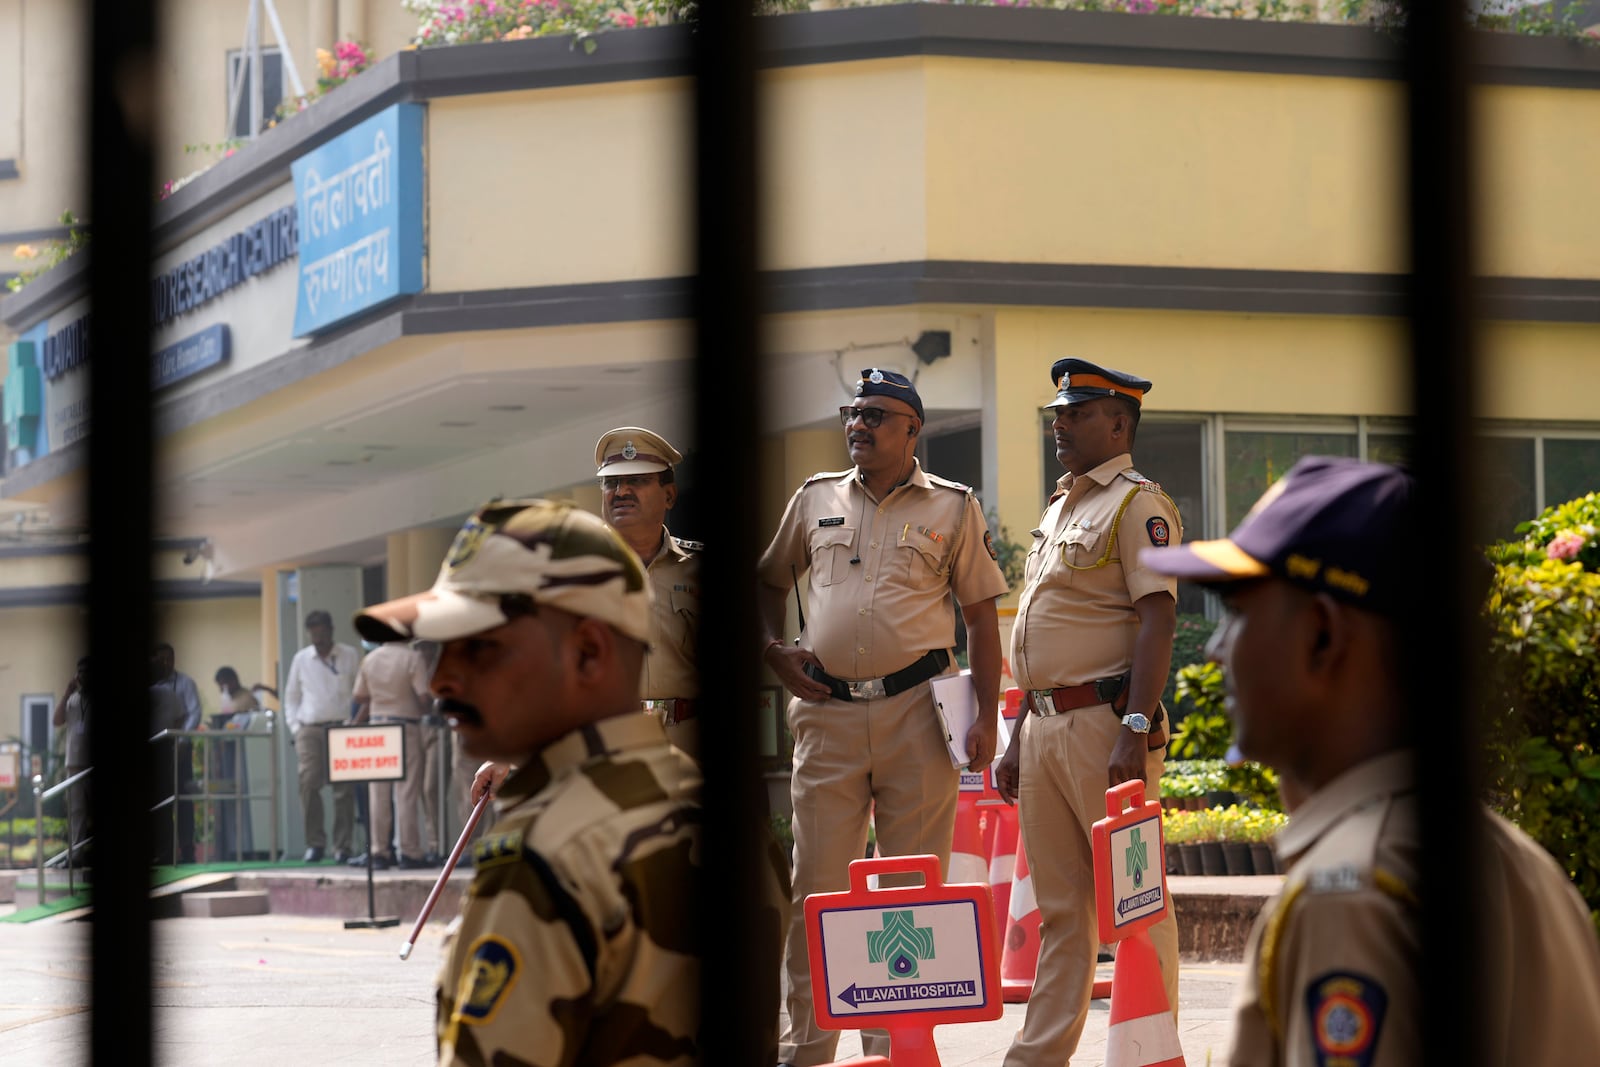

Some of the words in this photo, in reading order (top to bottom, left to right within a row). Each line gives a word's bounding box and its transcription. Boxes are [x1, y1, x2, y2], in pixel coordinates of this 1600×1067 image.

[304, 128, 391, 244] लिलावती
[170, 231, 241, 318] RESEARCH
[303, 226, 390, 316] रुग्णालय
[333, 758, 349, 772] DO
[351, 757, 372, 770] NOT
[375, 755, 398, 769] SPIT
[346, 735, 385, 749] PLEASE
[853, 986, 907, 1002] LILAVATI
[910, 982, 973, 998] HOSPITAL
